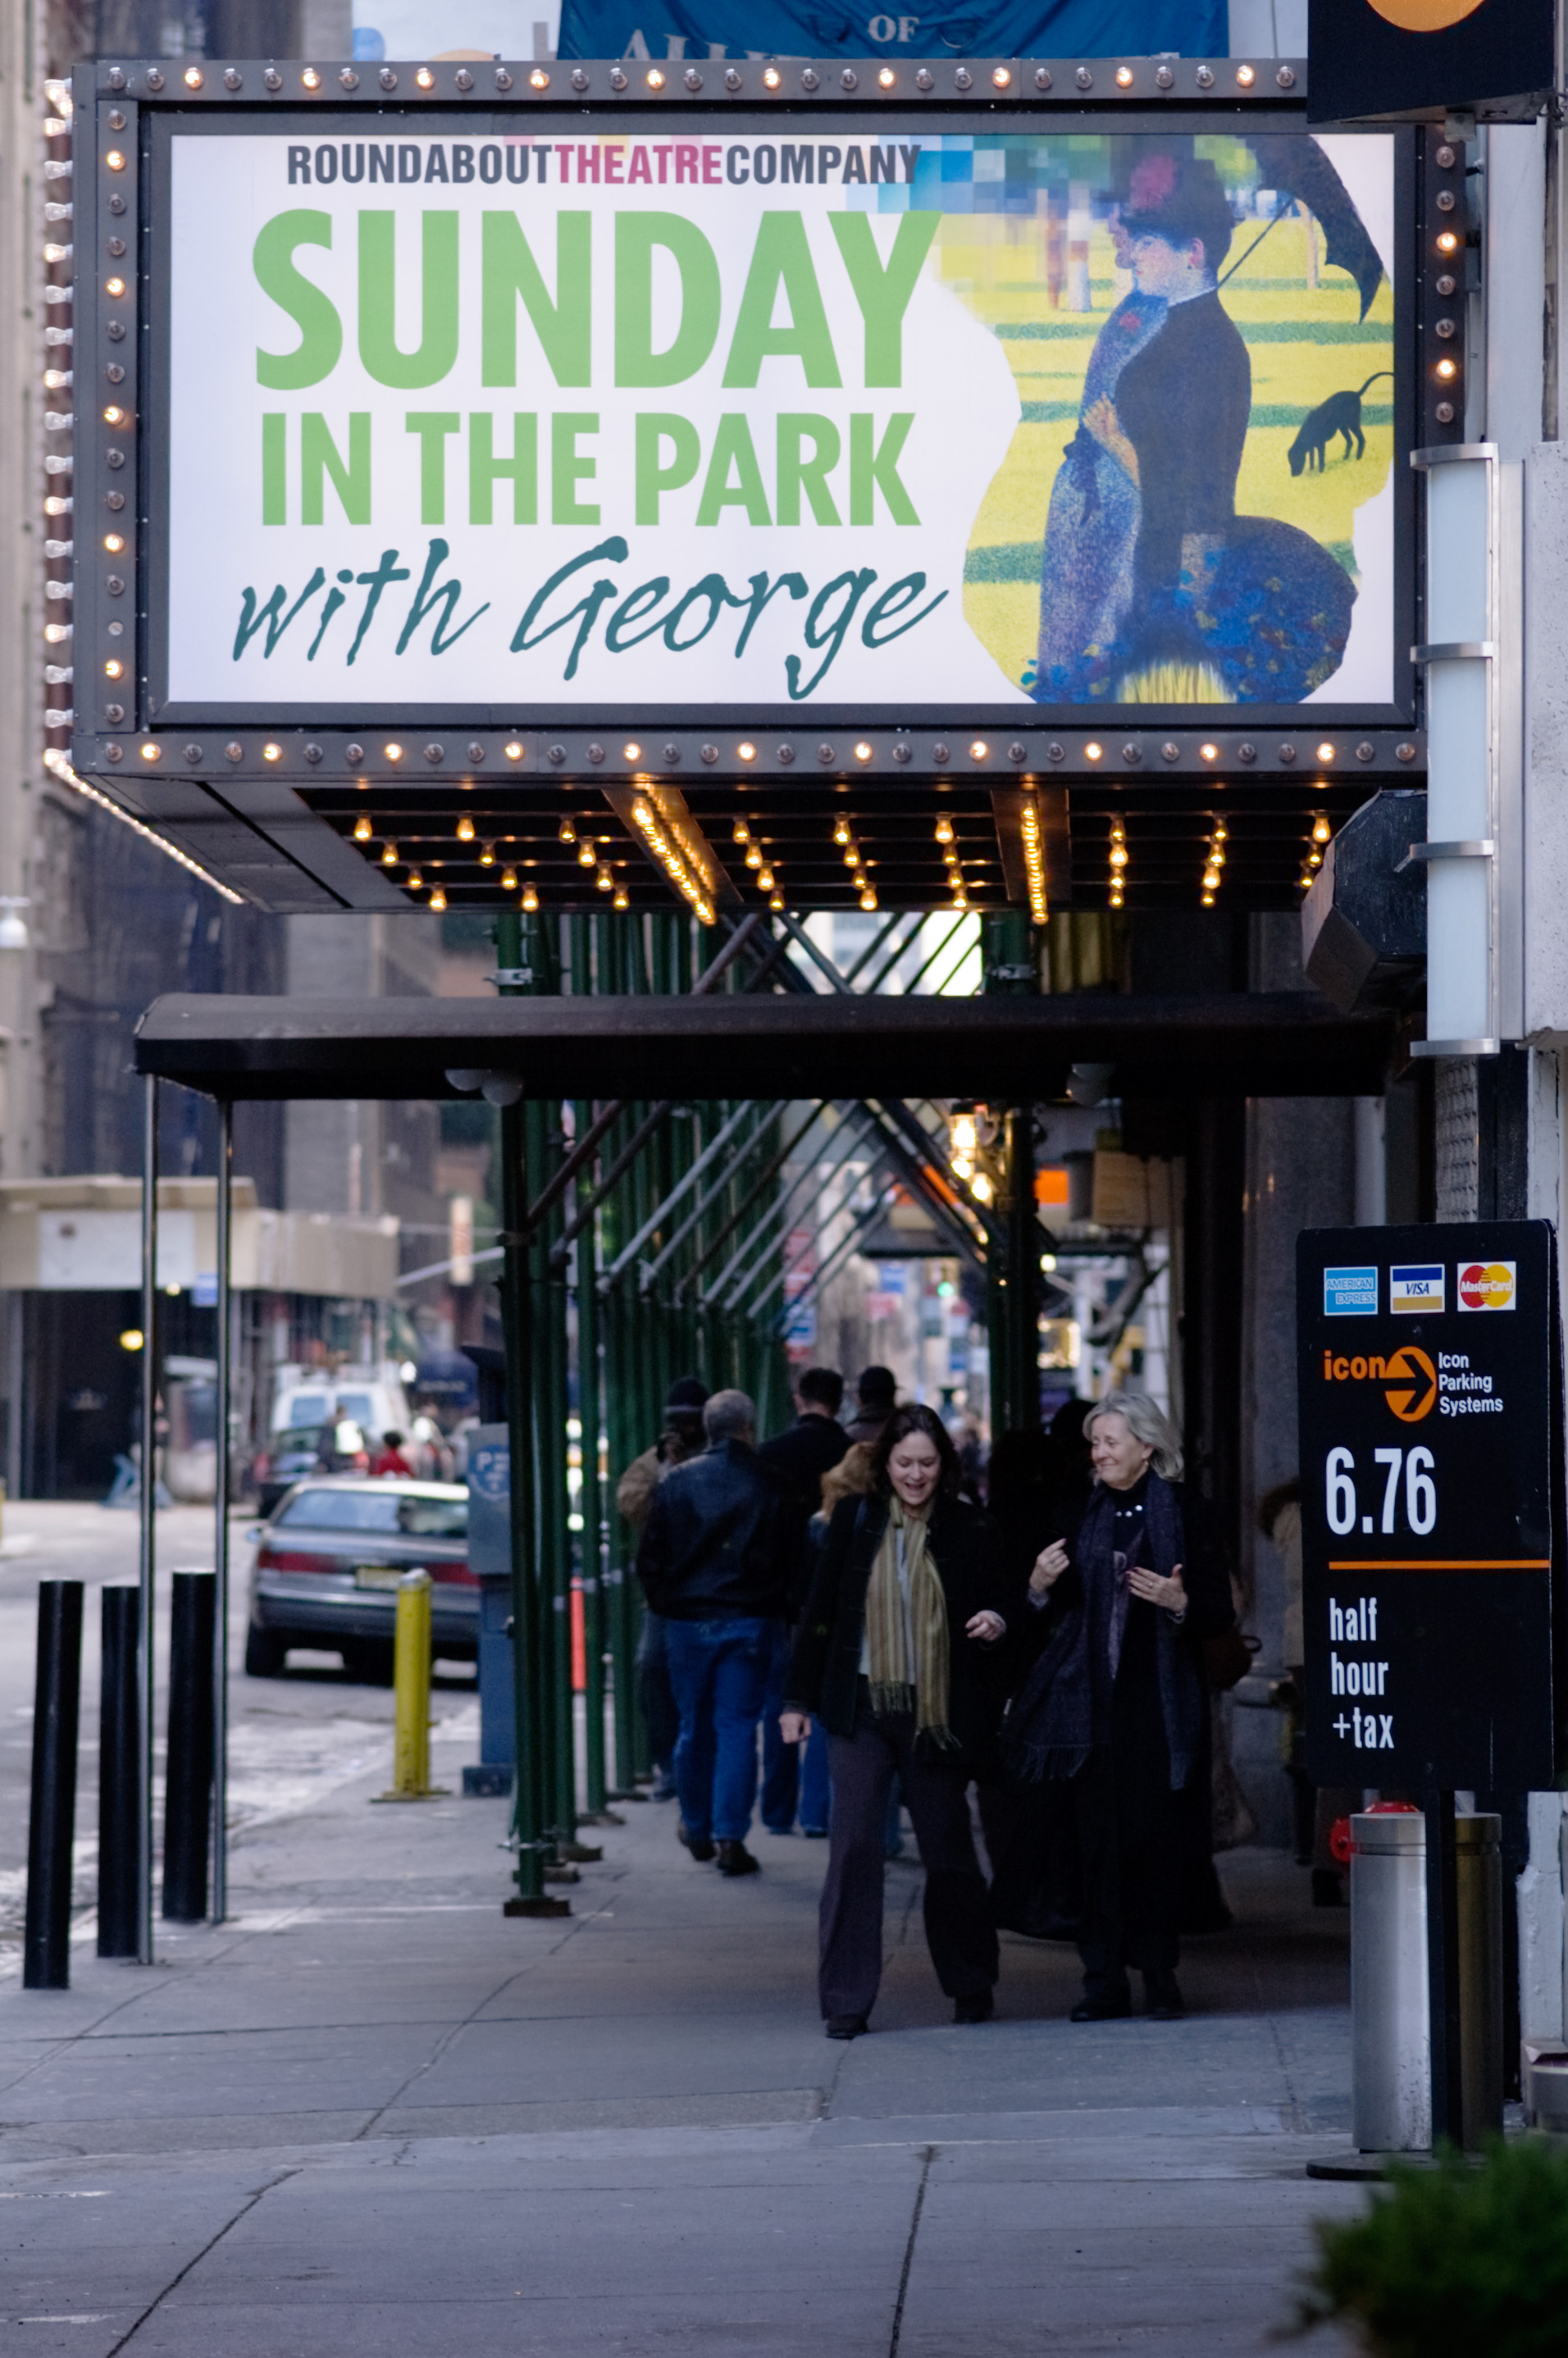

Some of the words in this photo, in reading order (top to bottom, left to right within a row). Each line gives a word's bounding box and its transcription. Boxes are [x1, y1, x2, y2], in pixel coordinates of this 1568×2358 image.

[868, 15, 920, 43] OF
[253, 208, 943, 390] SUNDAY
[262, 412, 372, 527] IN
[405, 412, 602, 527] THE
[635, 413, 922, 527] PARK
[232, 537, 491, 667] with
[509, 536, 950, 700] George
[1326, 1278, 1374, 1291] AMERICAN
[1335, 1291, 1376, 1305] EXPRESS
[1406, 1283, 1430, 1295] VISA
[1324, 1349, 1387, 1380] icon
[1438, 1351, 1470, 1369] Icon
[1438, 1372, 1493, 1393] Parking
[1439, 1396, 1504, 1417] Systems
[1325, 1445, 1437, 1535] 6.76
[1329, 1597, 1378, 1641] half
[1331, 1652, 1389, 1695] hour
[1333, 1706, 1395, 1749] +tax
